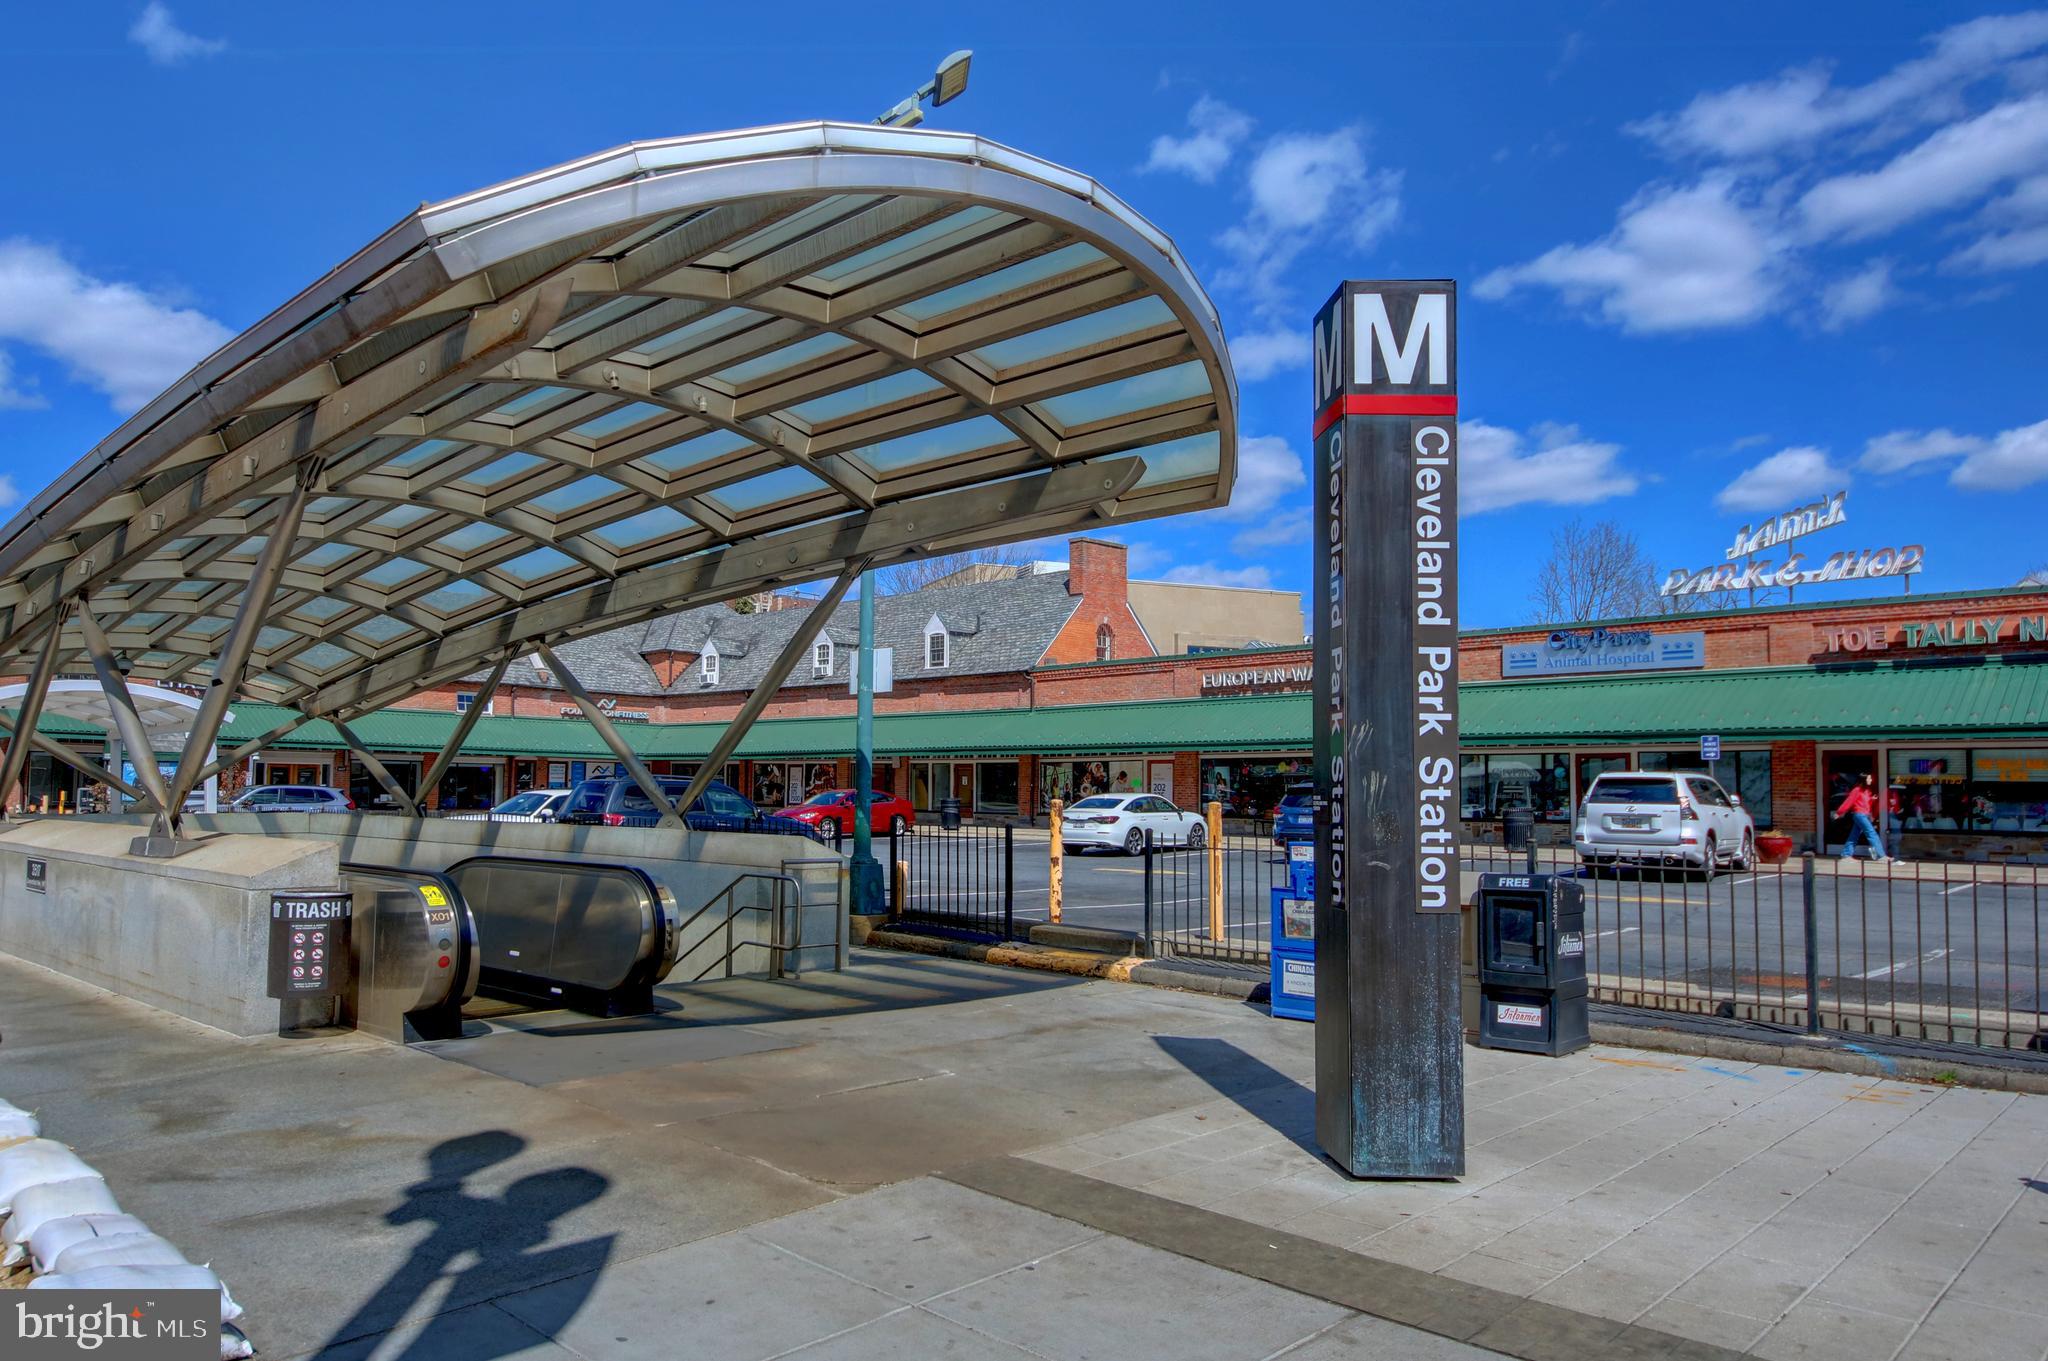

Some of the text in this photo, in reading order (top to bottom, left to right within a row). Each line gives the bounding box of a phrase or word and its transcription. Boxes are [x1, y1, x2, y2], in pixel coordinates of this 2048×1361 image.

[1315, 297, 1342, 411] M
[1353, 293, 1448, 385] M
[1661, 544, 1926, 596] PARK & SHOP
[1823, 625, 1888, 653] TOE
[1902, 617, 2006, 649] TALLY
[1202, 667, 1285, 688] EUROPEAN
[1330, 429, 1344, 904] Cleveland Park Station
[1415, 425, 1454, 908] Cleveland Park Station
[1544, 651, 1655, 668] Animal Hospital
[1499, 877, 1530, 888] FREE
[286, 901, 341, 919] TRASH
